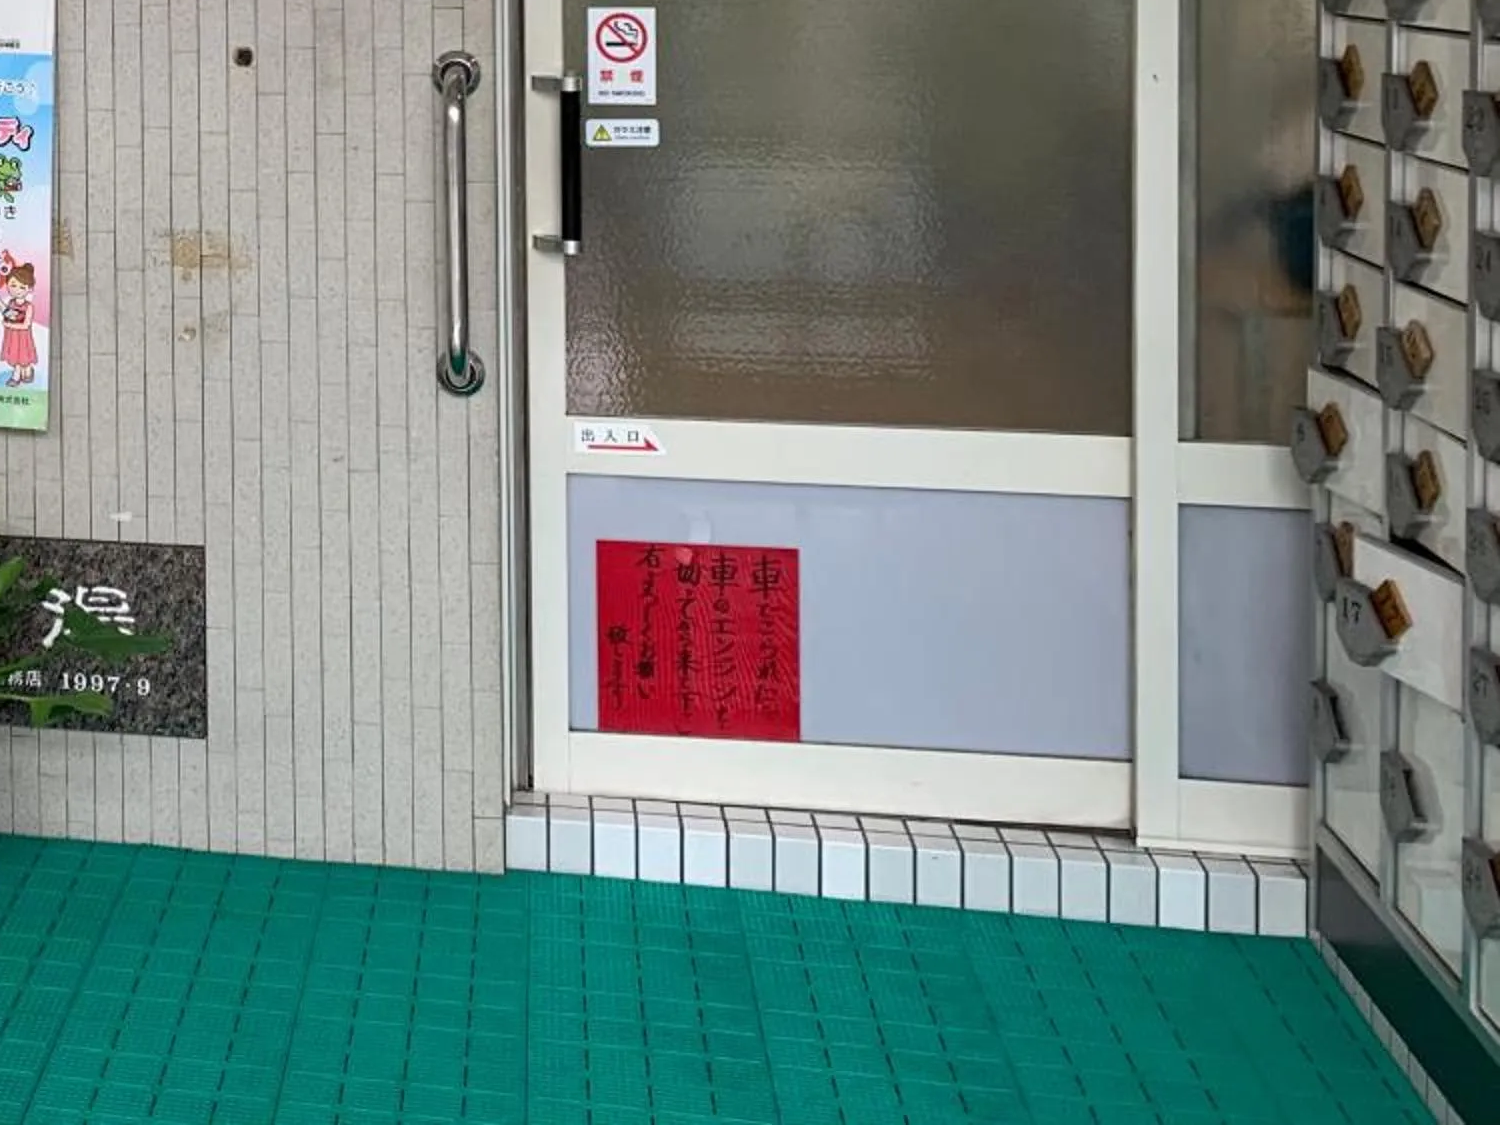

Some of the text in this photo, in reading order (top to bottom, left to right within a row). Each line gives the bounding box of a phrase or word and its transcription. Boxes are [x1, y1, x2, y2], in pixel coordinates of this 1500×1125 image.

[581, 428, 639, 442] 出入口
[1341, 595, 1363, 625] 17
